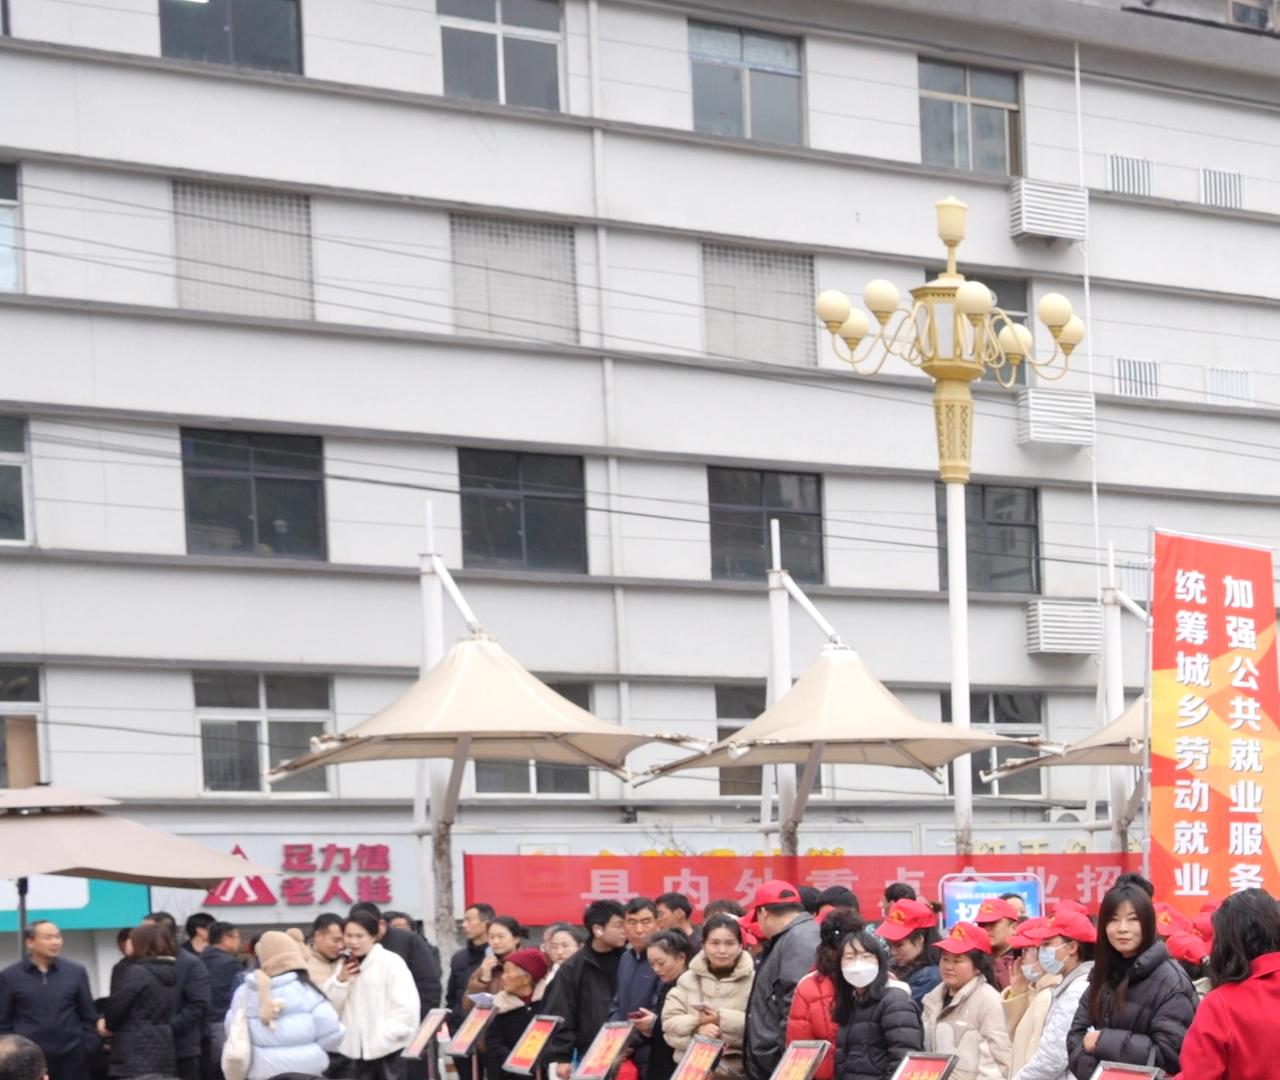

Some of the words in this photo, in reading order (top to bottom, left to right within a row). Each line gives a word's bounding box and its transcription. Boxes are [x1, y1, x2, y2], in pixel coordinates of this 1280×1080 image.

[1173, 569, 1212, 896] 统筹城乡劳动就业
[1222, 575, 1264, 889] 加强公共就业服务
[280, 876, 392, 905] 老人鞋
[281, 843, 391, 873] 足力健
